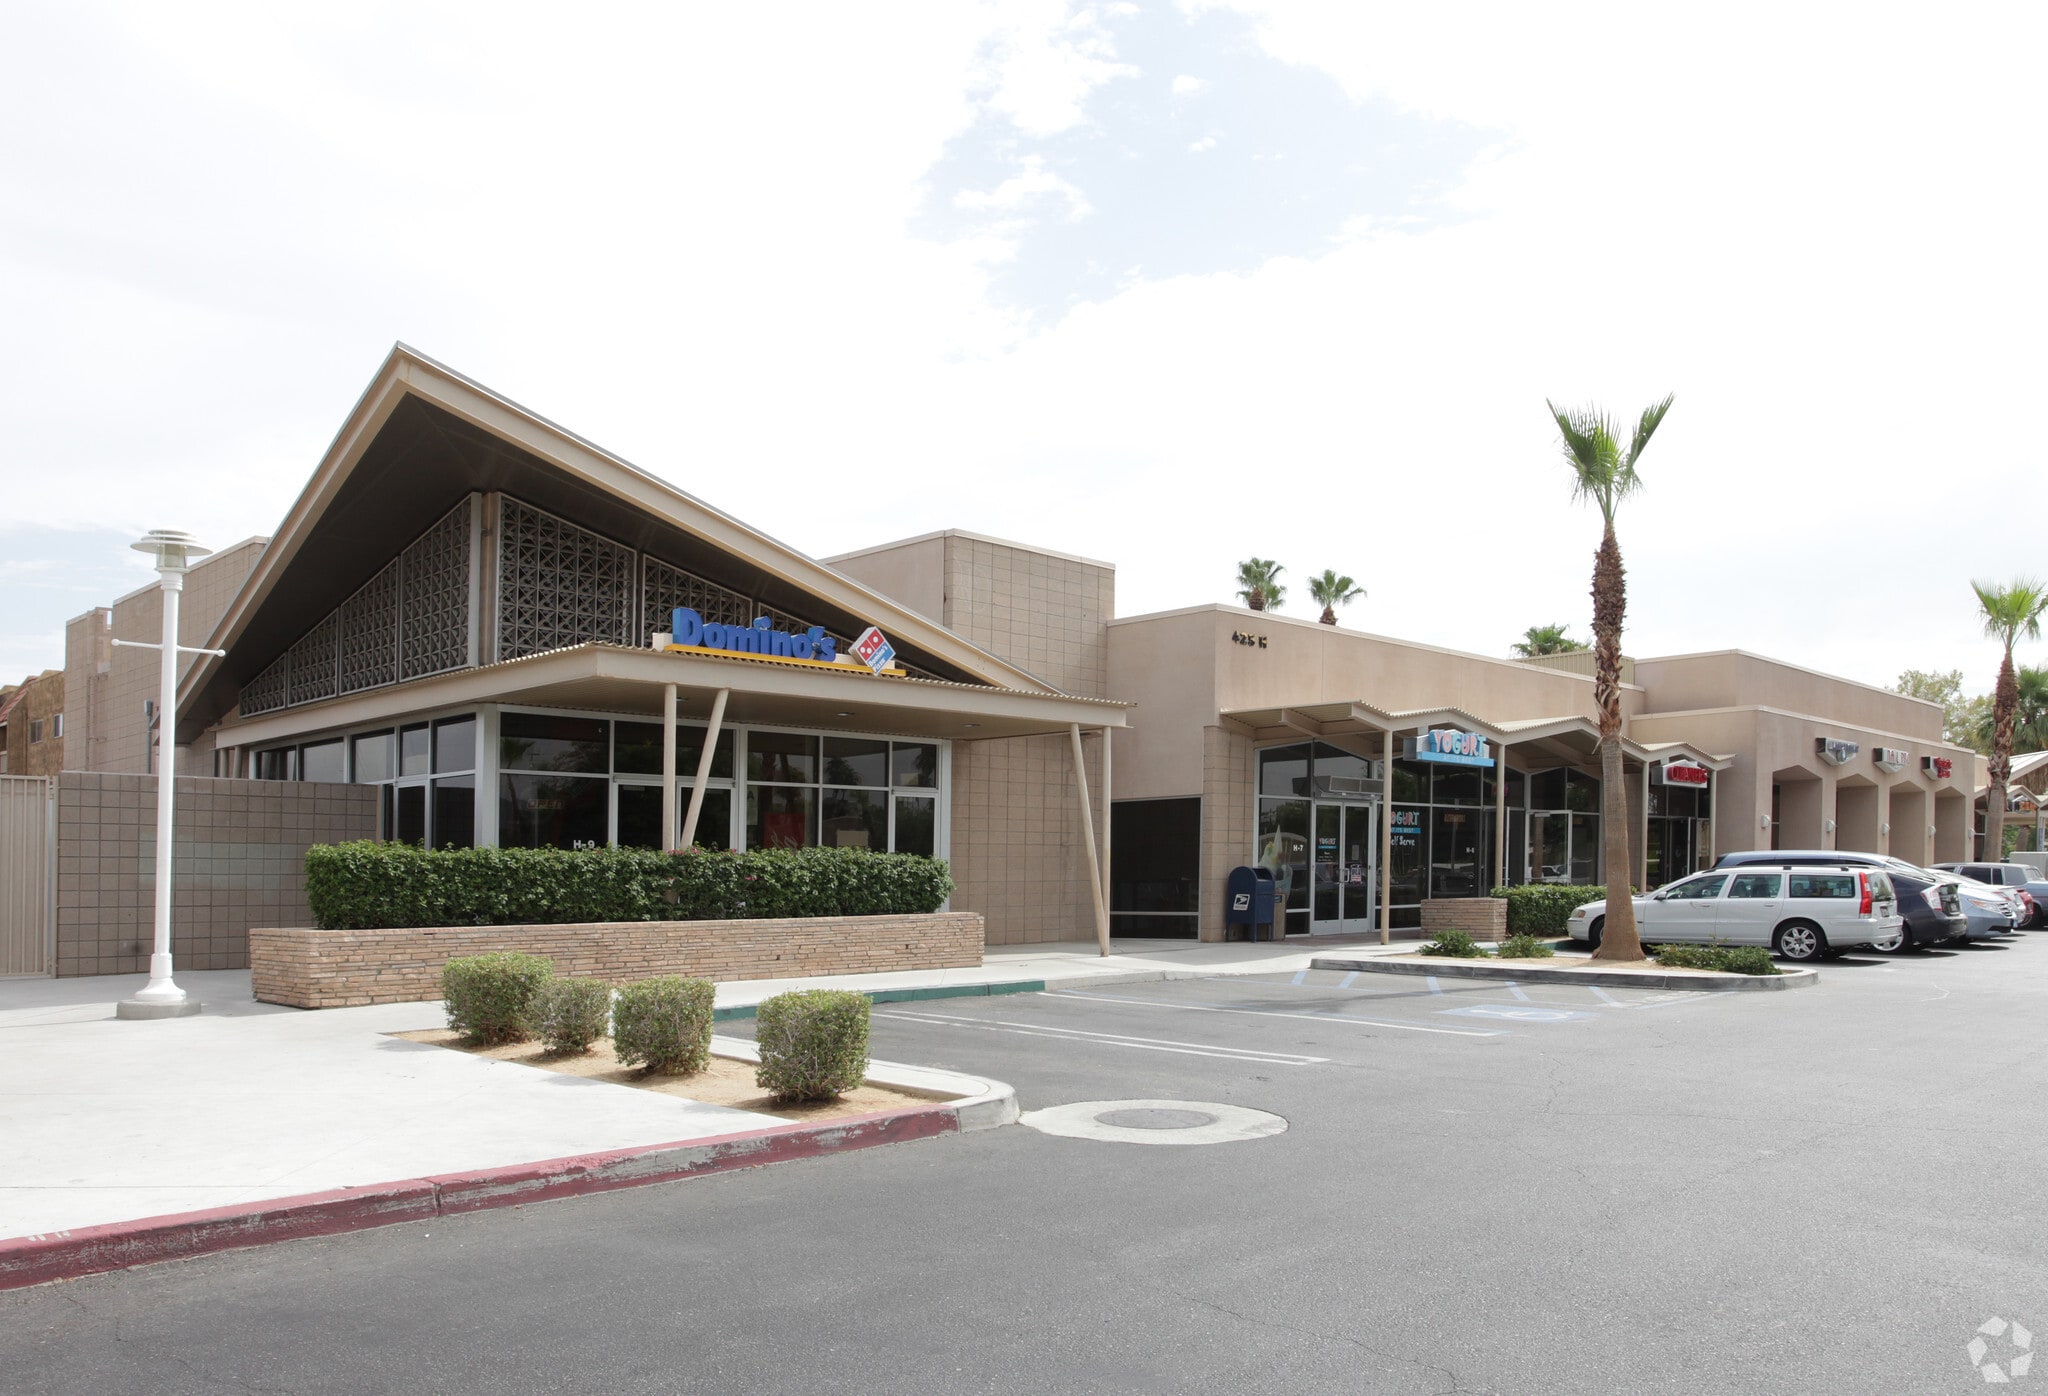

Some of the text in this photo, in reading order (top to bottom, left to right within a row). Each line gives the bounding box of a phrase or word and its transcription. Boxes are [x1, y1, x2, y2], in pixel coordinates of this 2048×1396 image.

[673, 607, 836, 663] Domino's
[1431, 729, 1487, 757] YOGURT
[1391, 811, 1420, 826] OGURT
[573, 840, 596, 849] H-9
